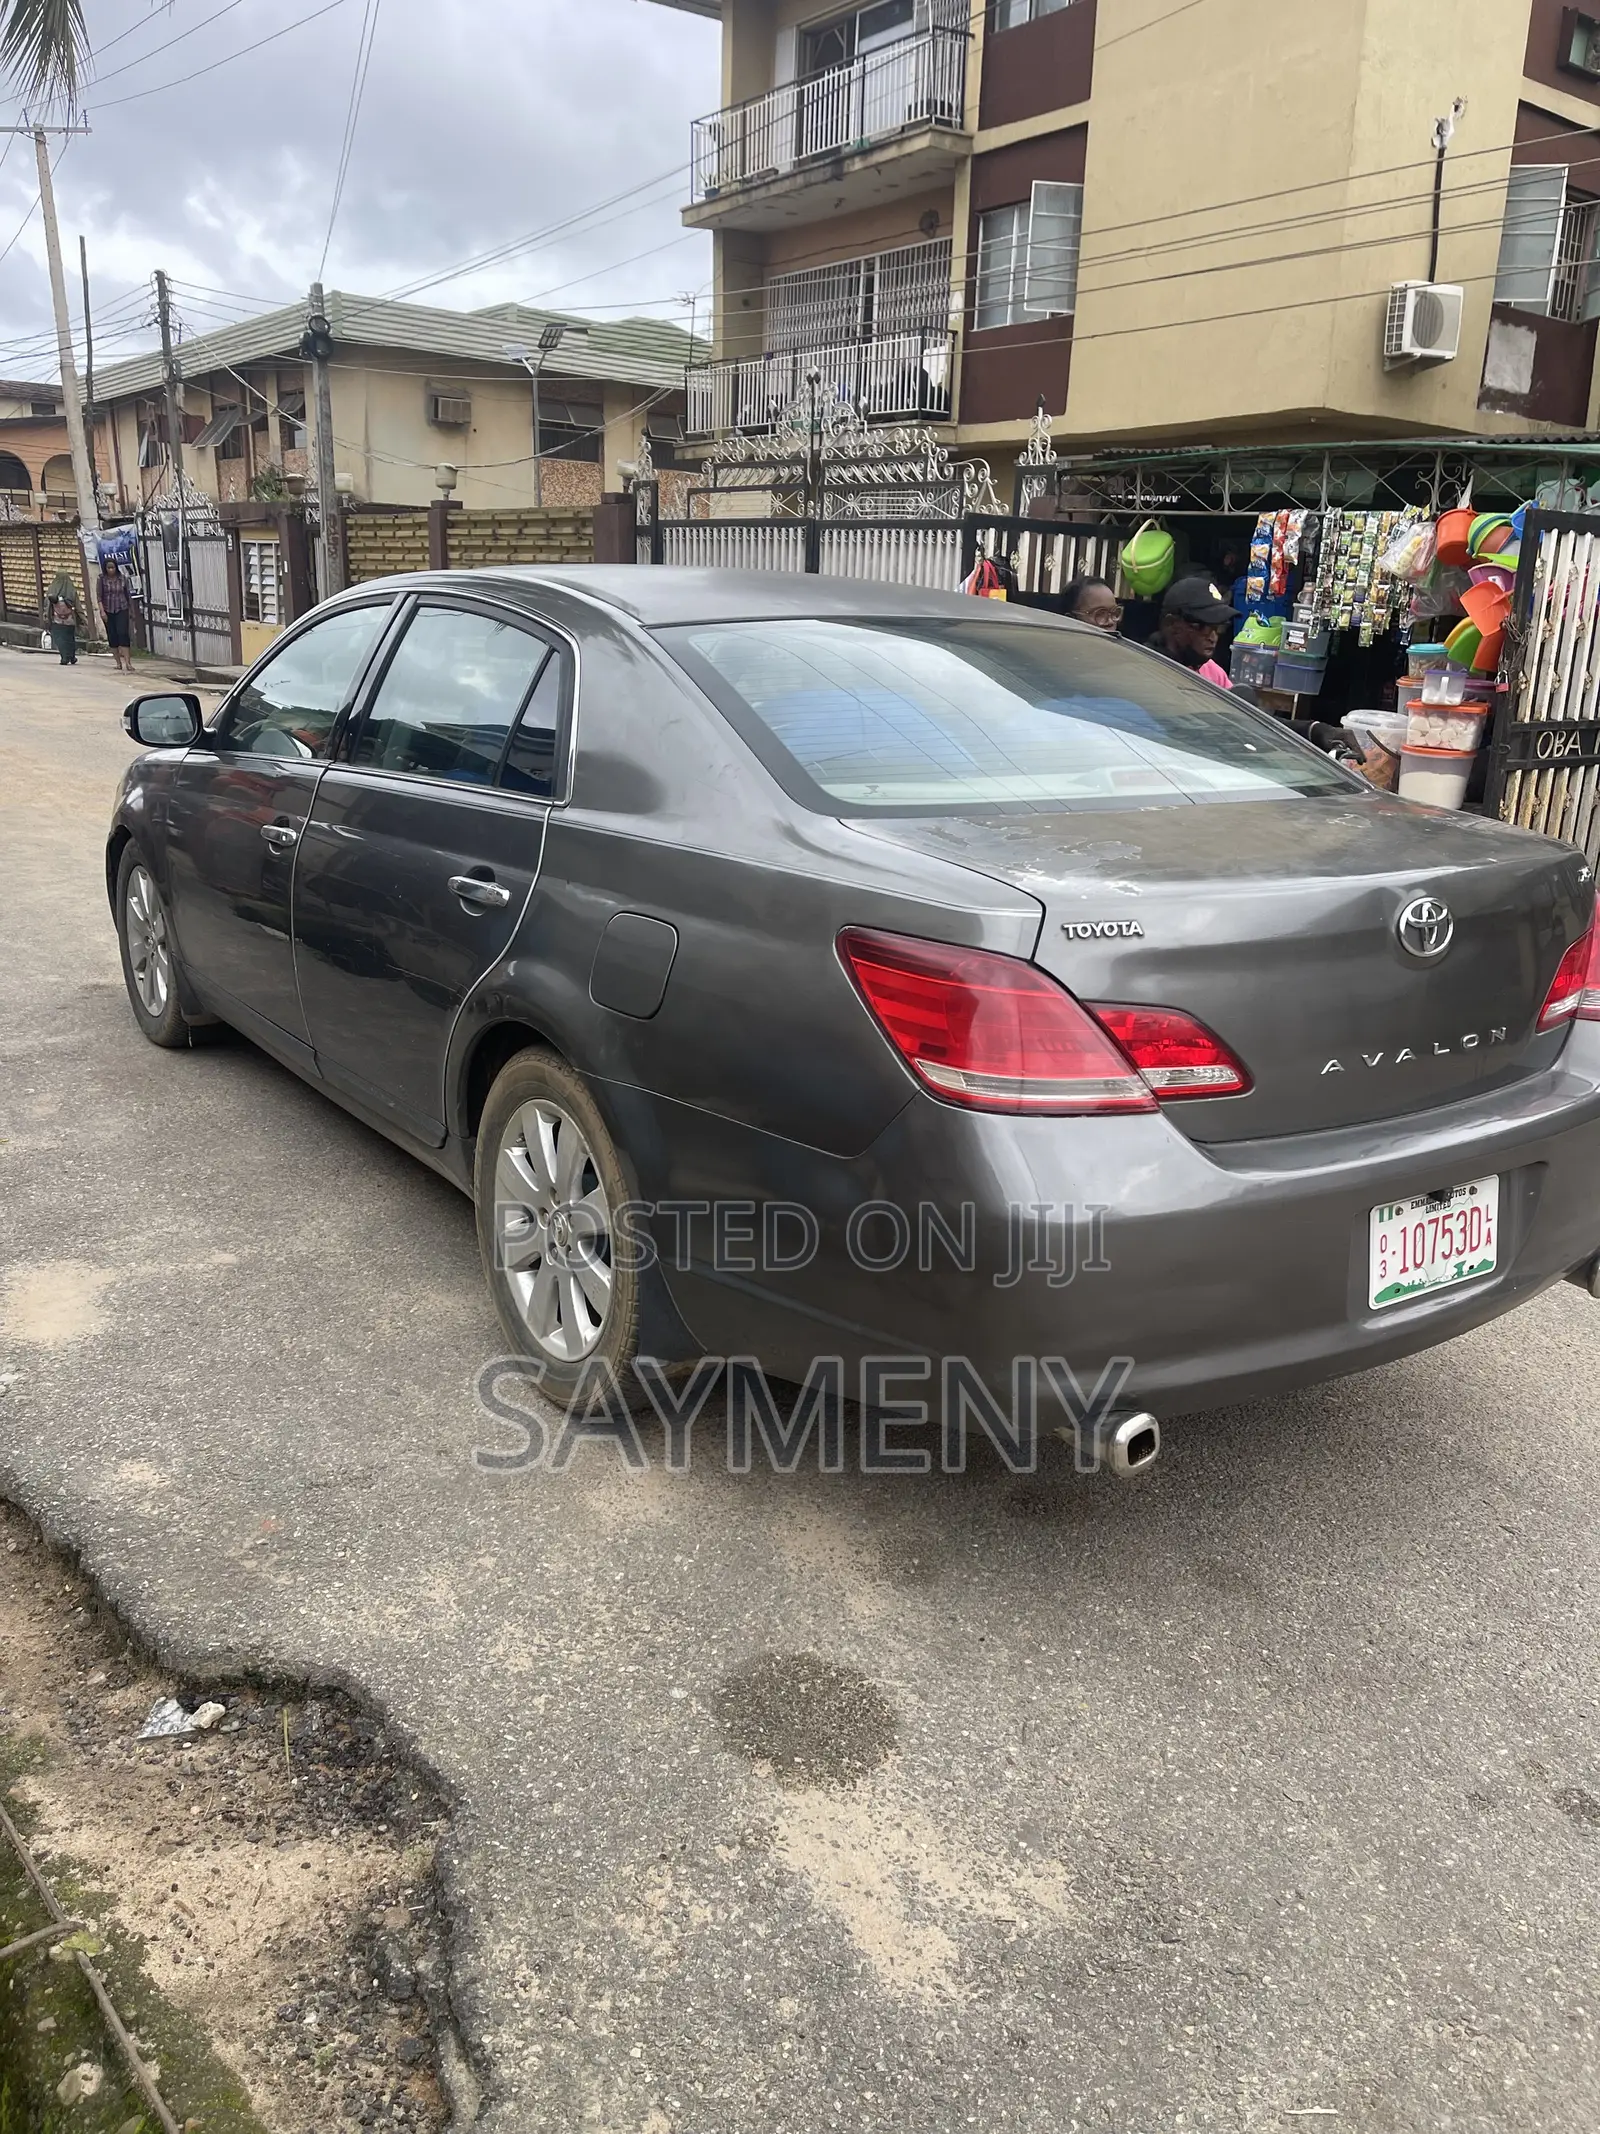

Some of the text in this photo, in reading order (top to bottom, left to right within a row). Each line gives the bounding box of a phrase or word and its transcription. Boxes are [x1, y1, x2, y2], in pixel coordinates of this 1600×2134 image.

[1536, 731, 1582, 759] OBA
[1062, 920, 1144, 940] TOYOTA
[1320, 1026, 1507, 1075] AVALON
[1425, 1200, 1452, 1214] LIMITED
